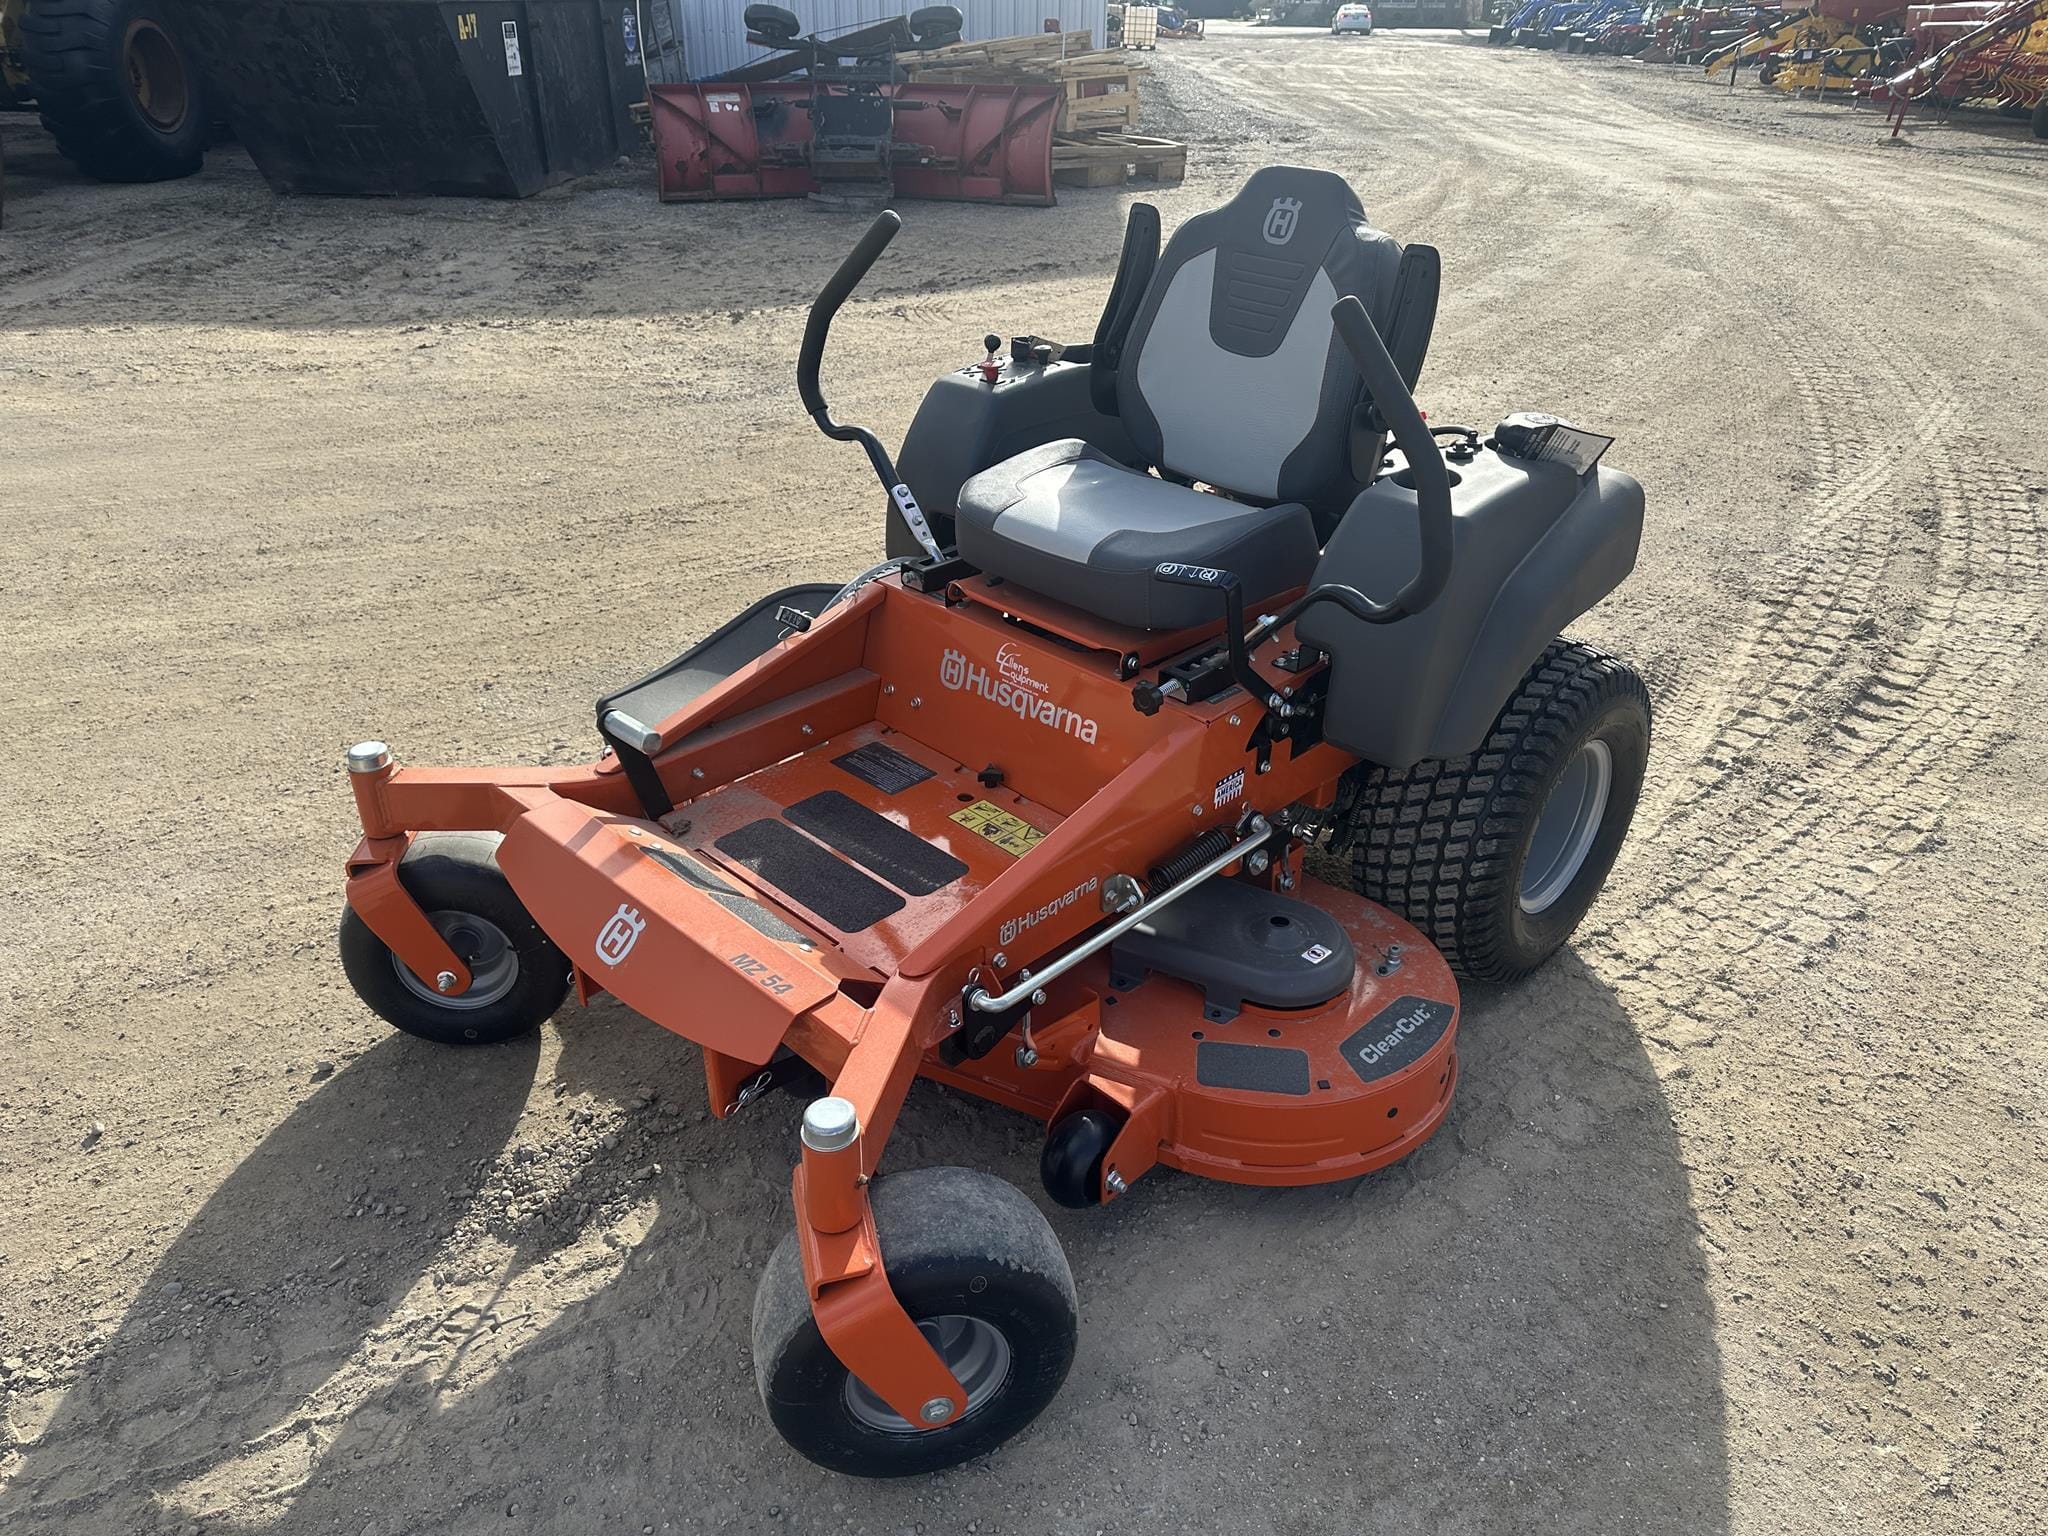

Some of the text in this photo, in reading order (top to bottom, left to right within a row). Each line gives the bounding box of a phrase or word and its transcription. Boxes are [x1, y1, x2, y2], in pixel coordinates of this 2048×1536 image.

[996, 643, 1030, 675] Ellens
[999, 653, 1049, 694] Equipment
[965, 662, 1098, 745] Husqvarna
[1018, 877, 1098, 934] Husqvarna
[730, 953, 794, 995] MZ 54
[1360, 1008, 1431, 1064] ClearCut
